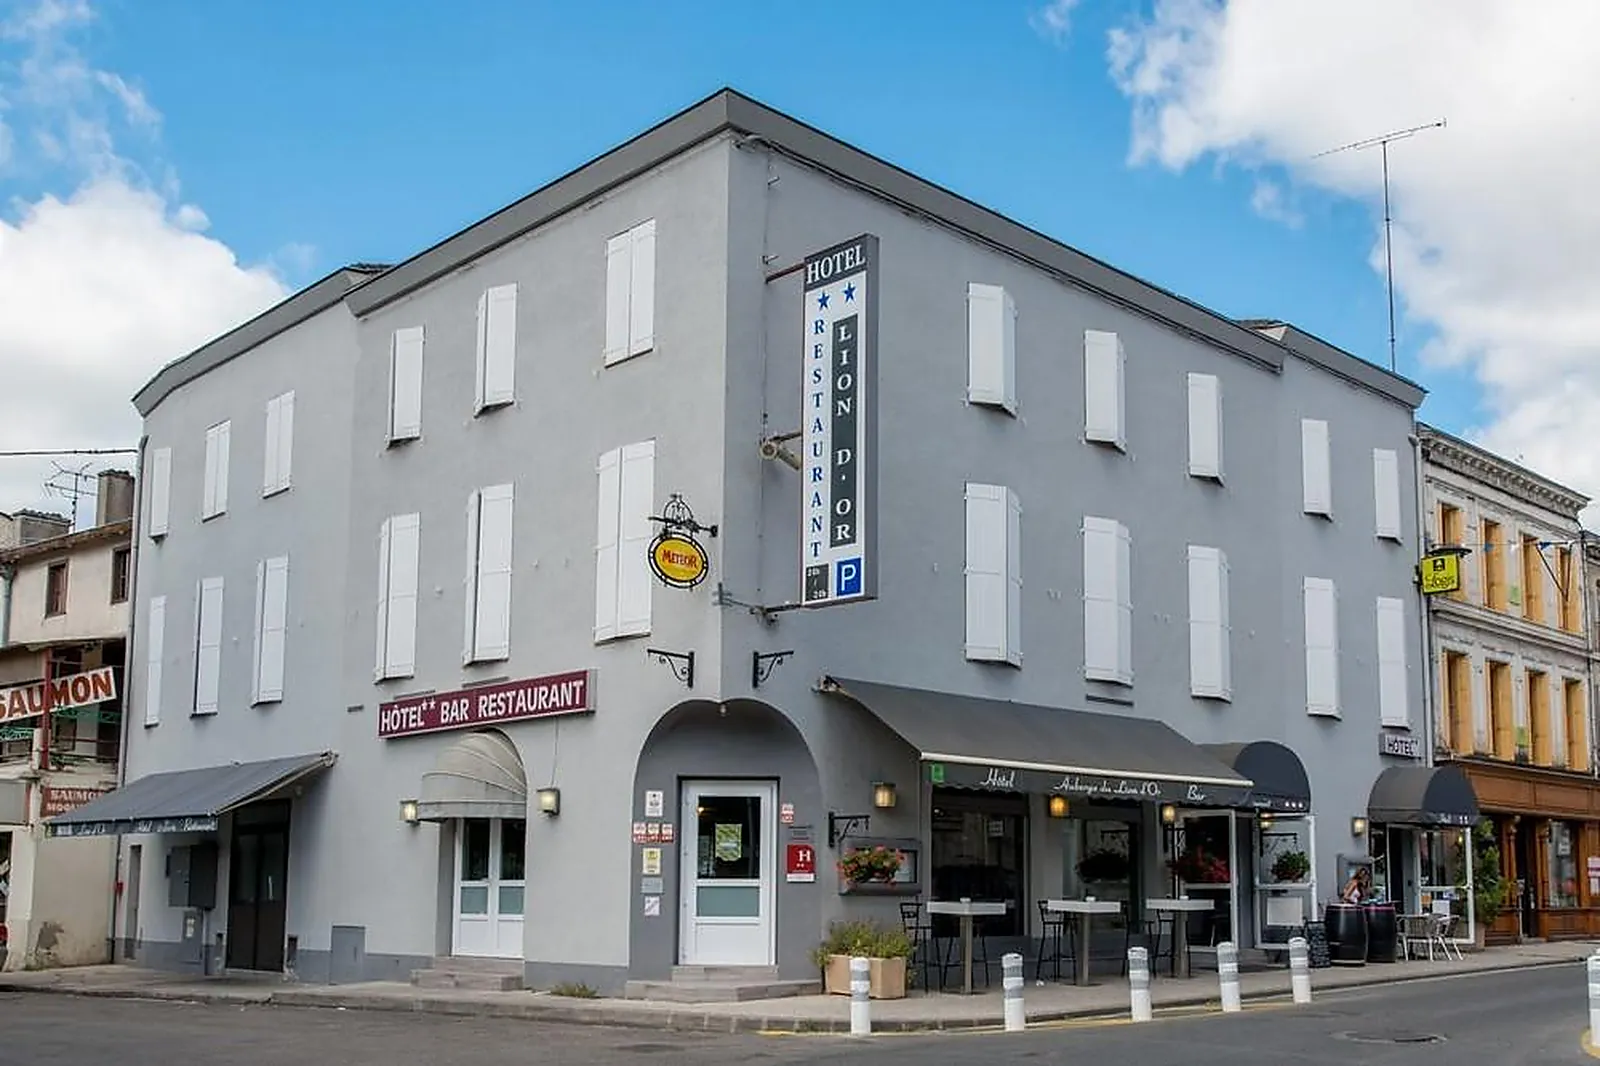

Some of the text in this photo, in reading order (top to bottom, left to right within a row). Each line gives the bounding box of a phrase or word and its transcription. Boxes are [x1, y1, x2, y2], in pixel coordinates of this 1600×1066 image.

[805, 244, 866, 285] HOTEL
[836, 325, 853, 418] LION
[810, 318, 827, 559] RESTAURANT
[841, 564, 857, 592] P
[440, 700, 469, 724] BAR
[477, 679, 585, 719] RESTAURANT
[1053, 776, 1098, 794] Auberge
[1099, 783, 1112, 794] du
[1187, 784, 1206, 802] Bar
[798, 849, 812, 862] H
